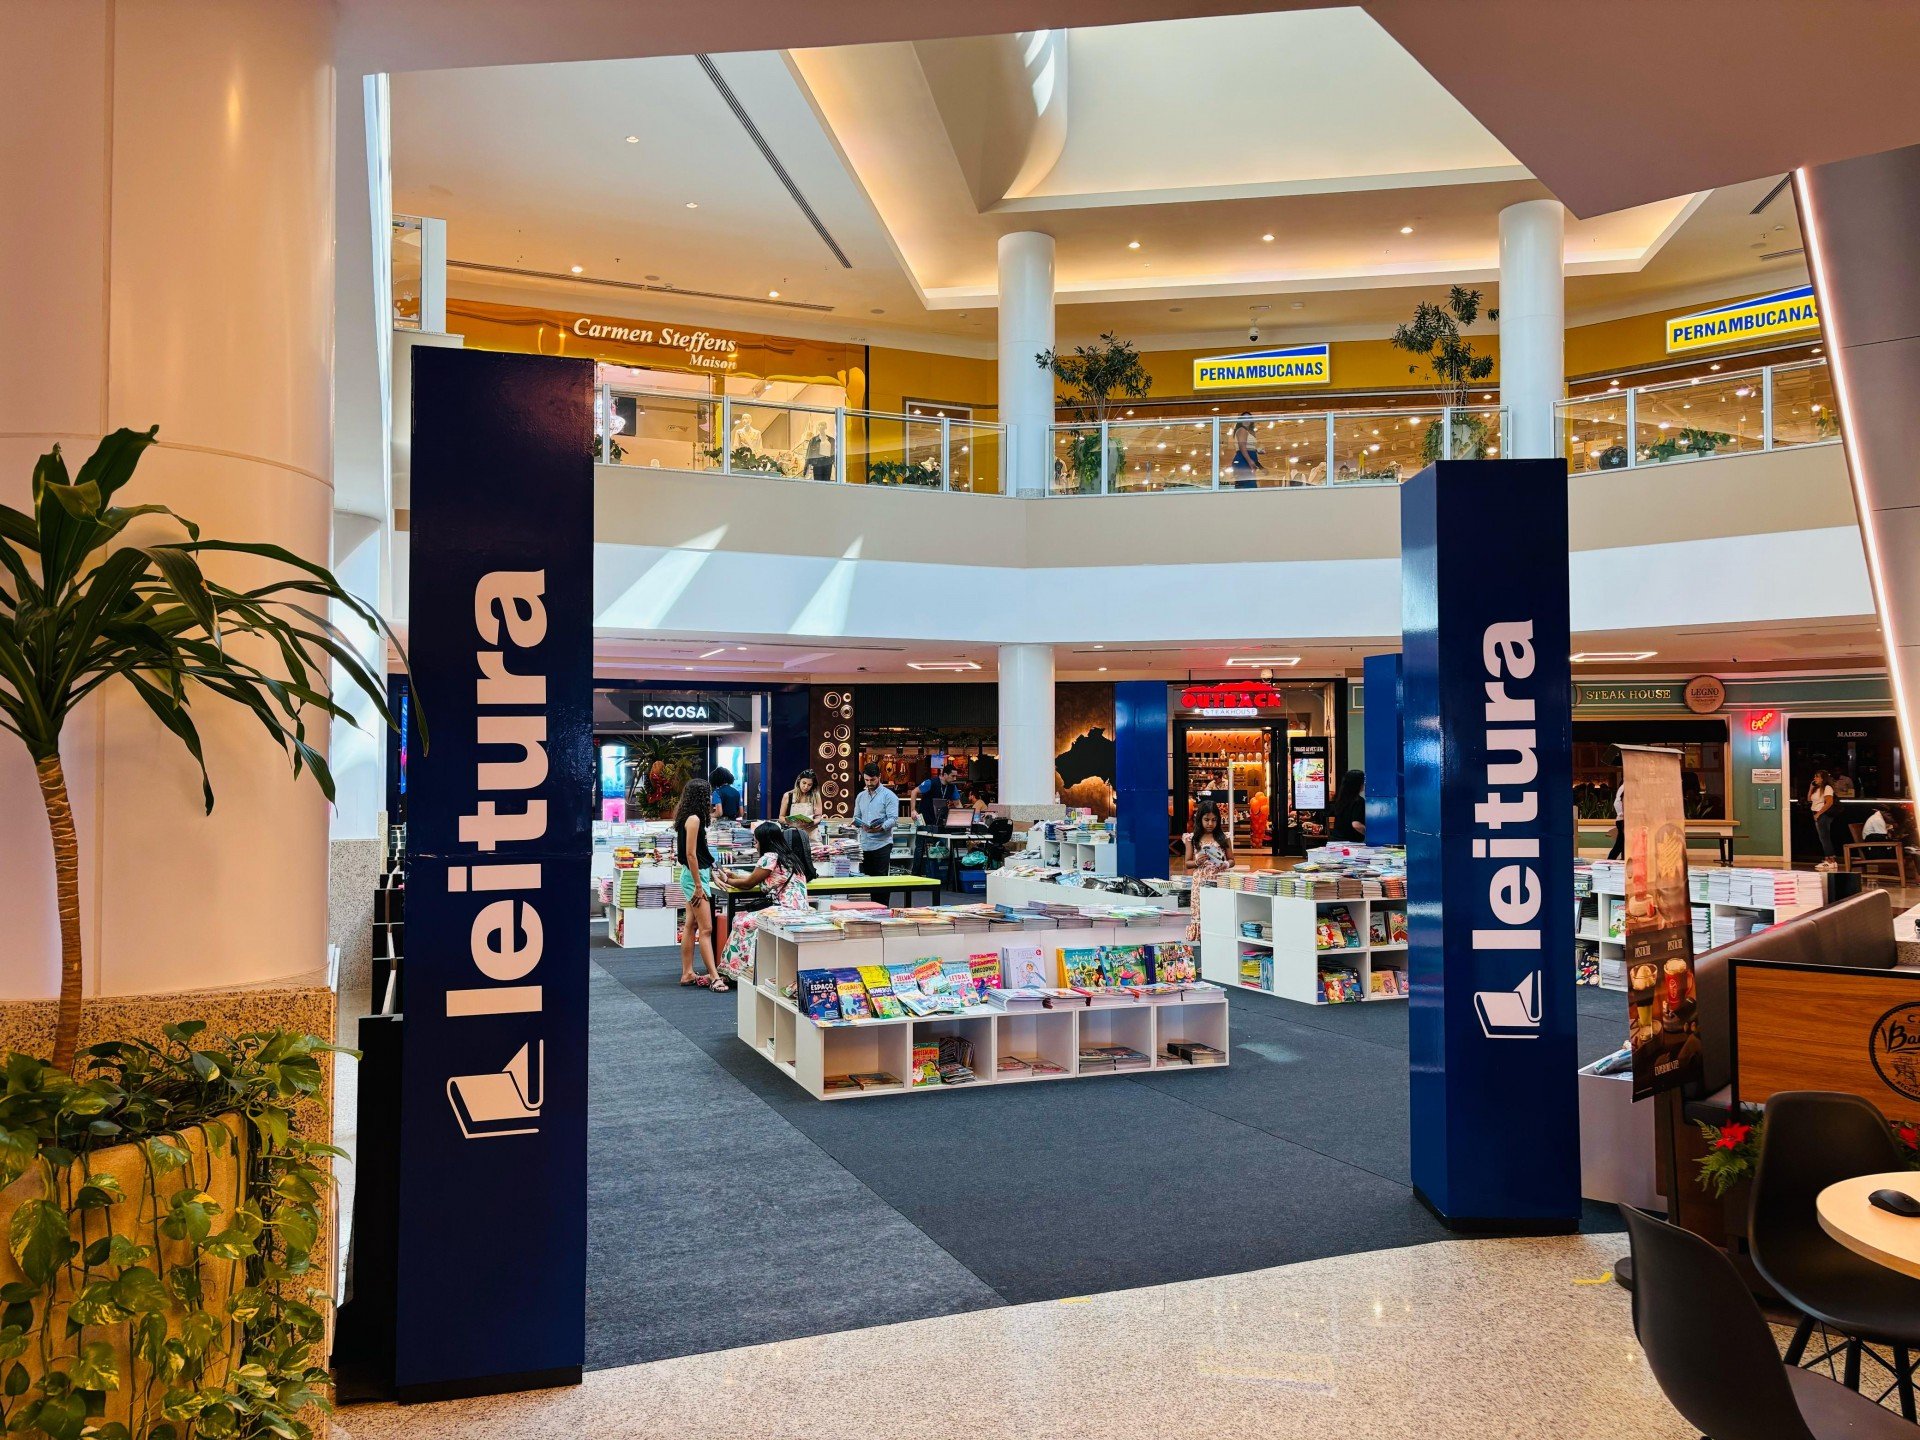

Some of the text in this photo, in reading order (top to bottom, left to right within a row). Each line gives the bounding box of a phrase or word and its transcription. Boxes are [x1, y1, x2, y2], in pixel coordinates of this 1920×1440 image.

[573, 318, 737, 353] Carmen Steffens
[688, 353, 737, 370] Maison
[1200, 362, 1323, 381] PERNAMBUCANAS
[1586, 689, 1671, 700] STEAK HOUSE
[1691, 687, 1719, 696] LEGNO
[1181, 693, 1281, 708] OUTBACK
[642, 705, 707, 719] CYCOSA
[1204, 708, 1256, 716] STEAKHOUSE
[1751, 710, 1774, 731] Open
[446, 568, 549, 1018] leitura
[1472, 619, 1542, 950] leitura
